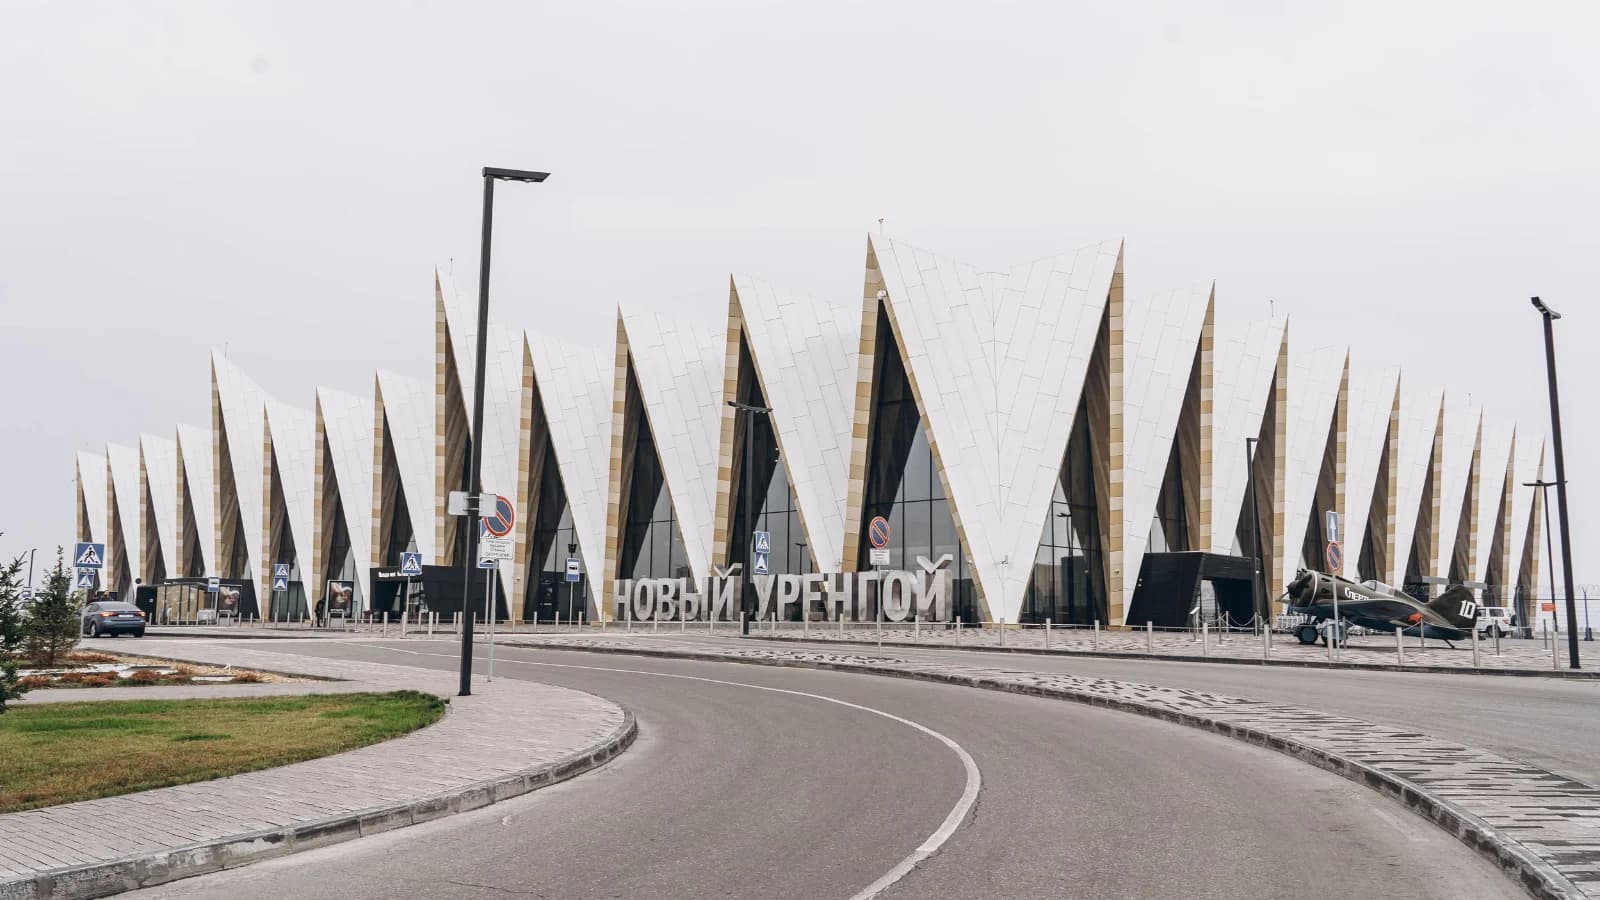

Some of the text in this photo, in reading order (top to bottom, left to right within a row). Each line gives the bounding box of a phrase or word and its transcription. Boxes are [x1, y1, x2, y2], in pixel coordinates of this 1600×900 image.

[613, 554, 953, 622] НОВЫЙ УРЕНГОЙ
[1458, 600, 1476, 619] 10
